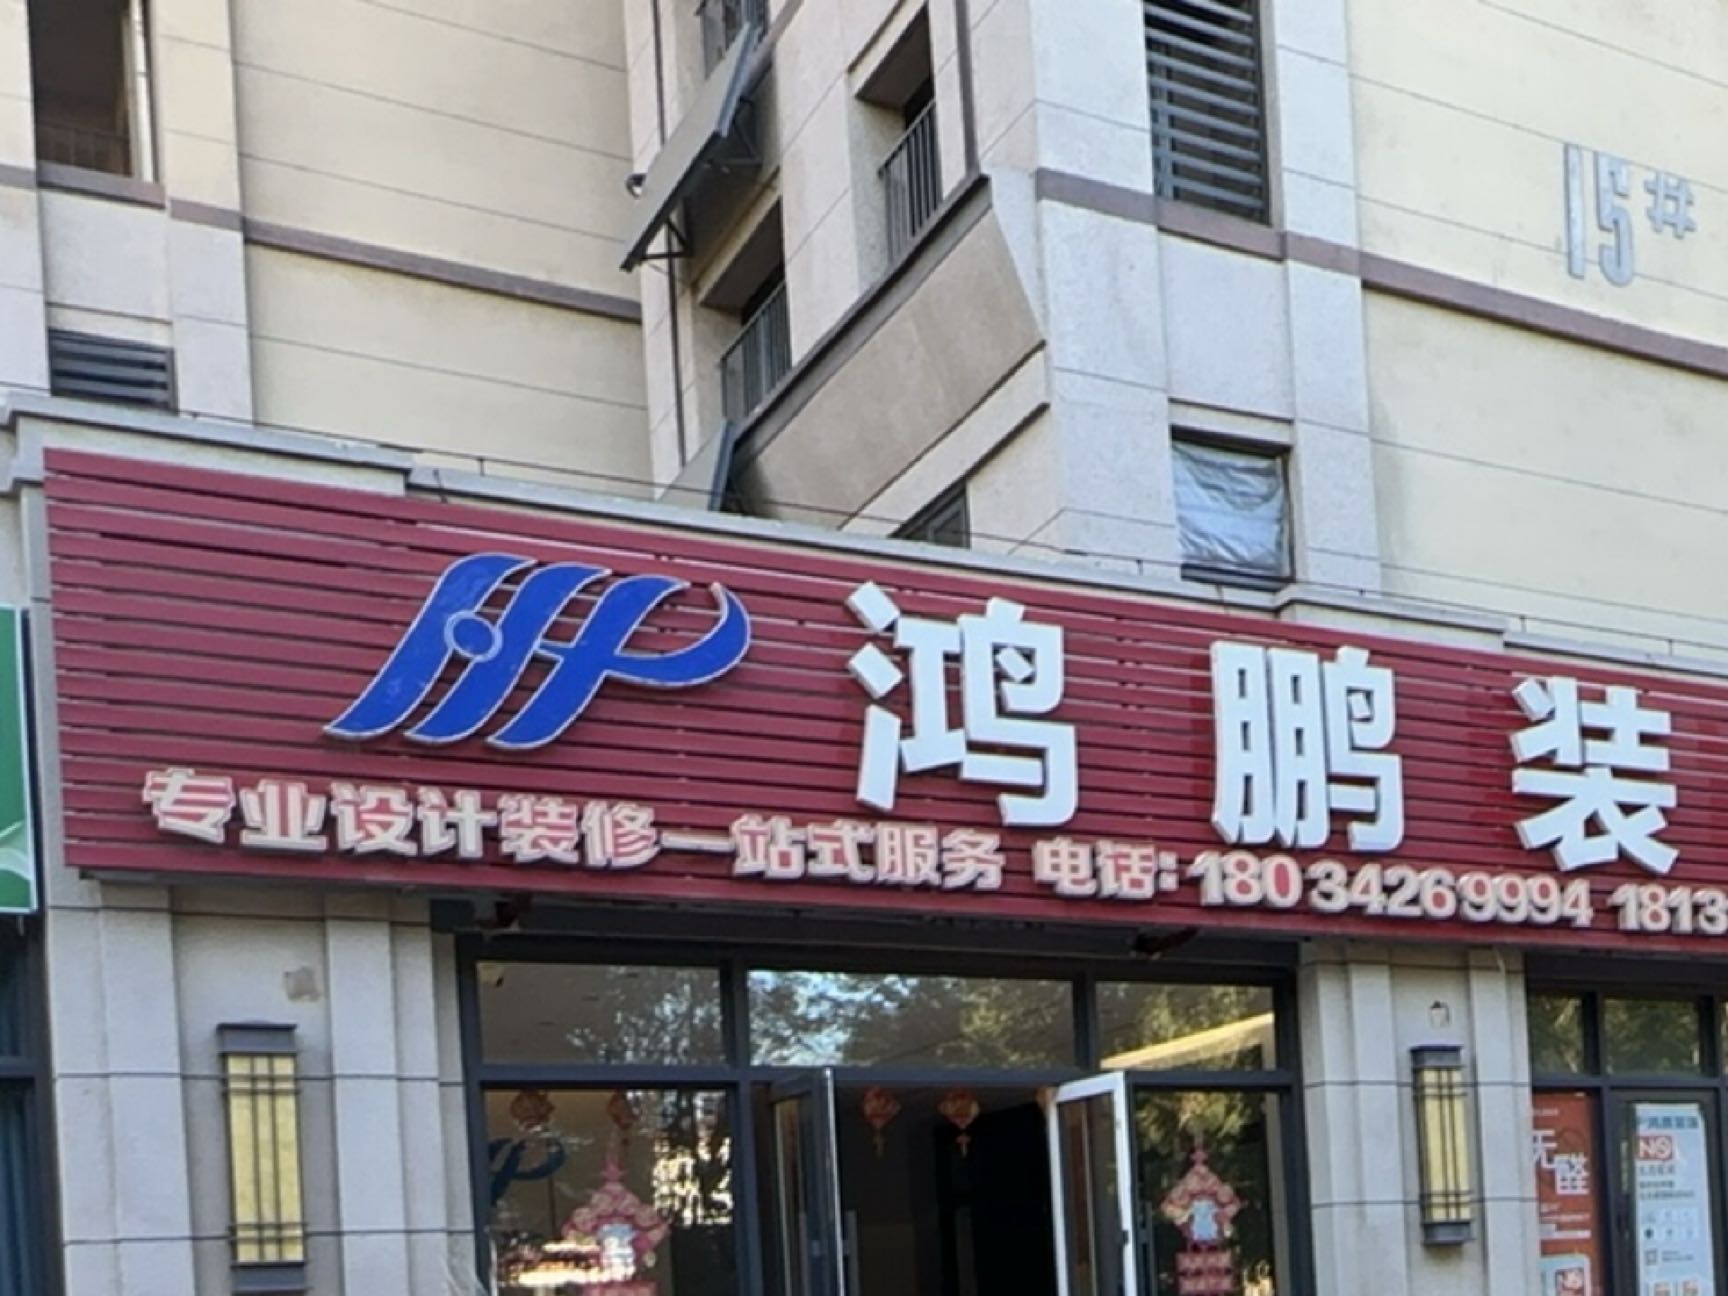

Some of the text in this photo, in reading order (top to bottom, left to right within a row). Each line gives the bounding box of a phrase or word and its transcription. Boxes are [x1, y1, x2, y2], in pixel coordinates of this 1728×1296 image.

[142, 767, 1007, 890] 专业设计装修一站式服务
